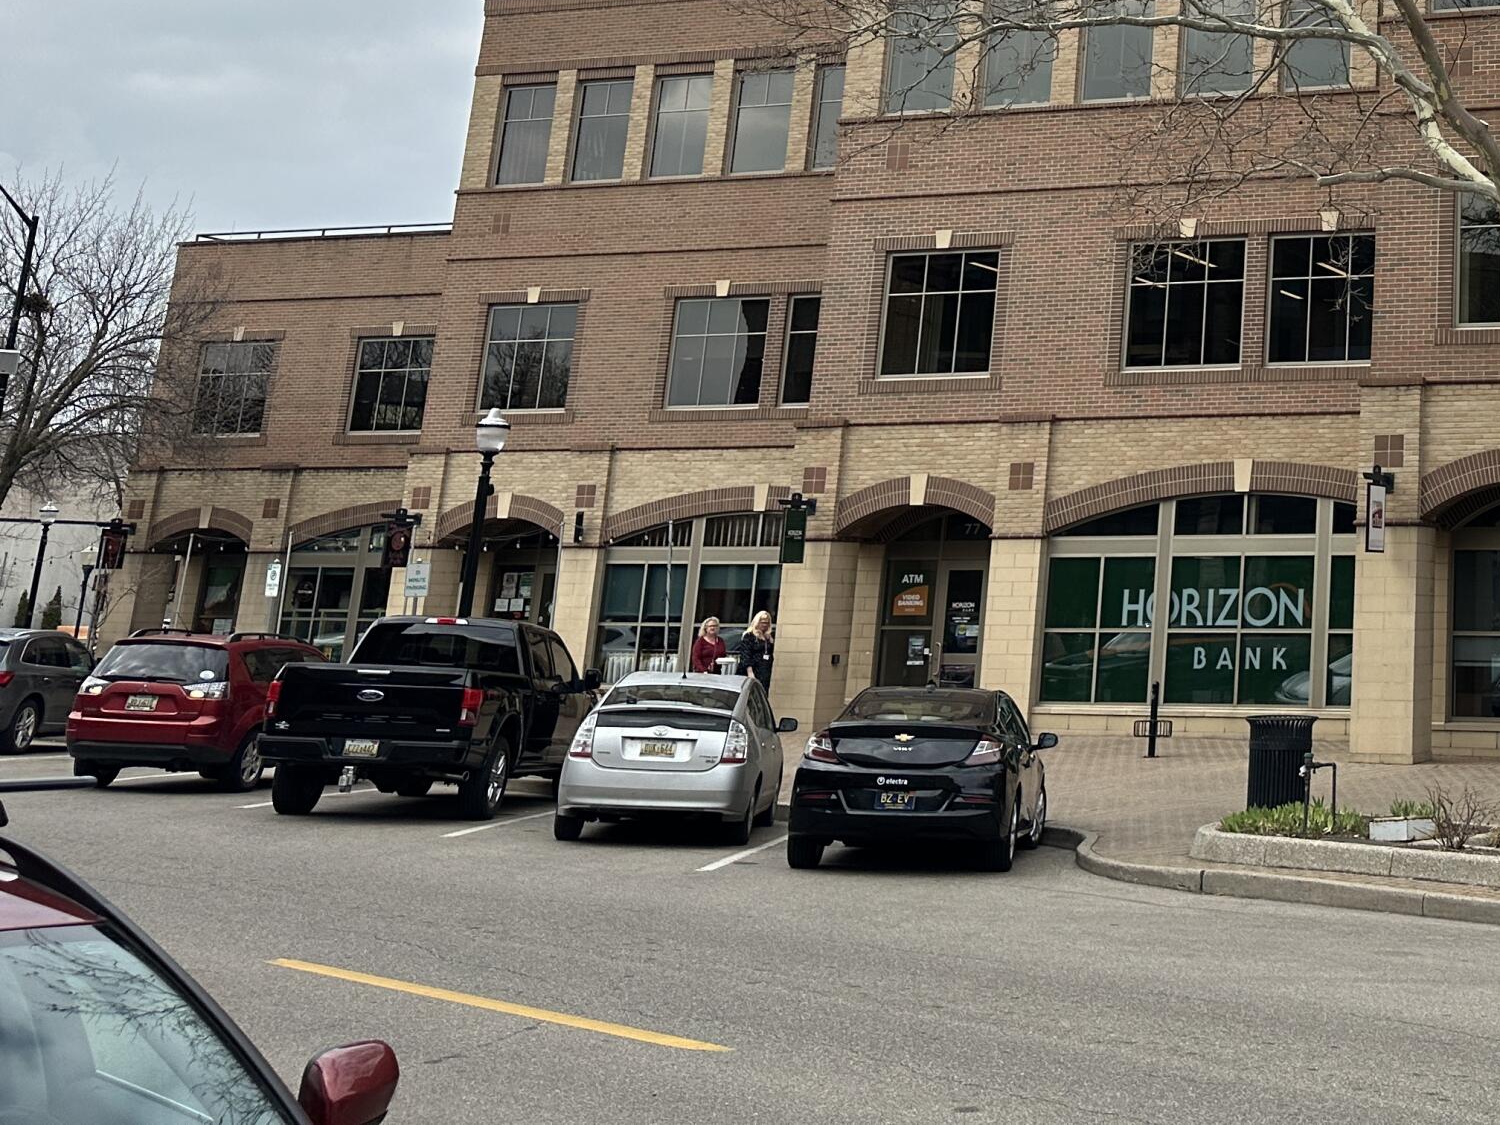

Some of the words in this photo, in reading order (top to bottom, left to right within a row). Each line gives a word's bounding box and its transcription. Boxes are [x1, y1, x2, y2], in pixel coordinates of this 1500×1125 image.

[964, 523, 981, 535] 77
[901, 574, 924, 584] ATM
[1120, 586, 1305, 628] HORIZON
[1192, 647, 1288, 670] BANK
[881, 793, 893, 803] BZ
[897, 793, 910, 804] EV
